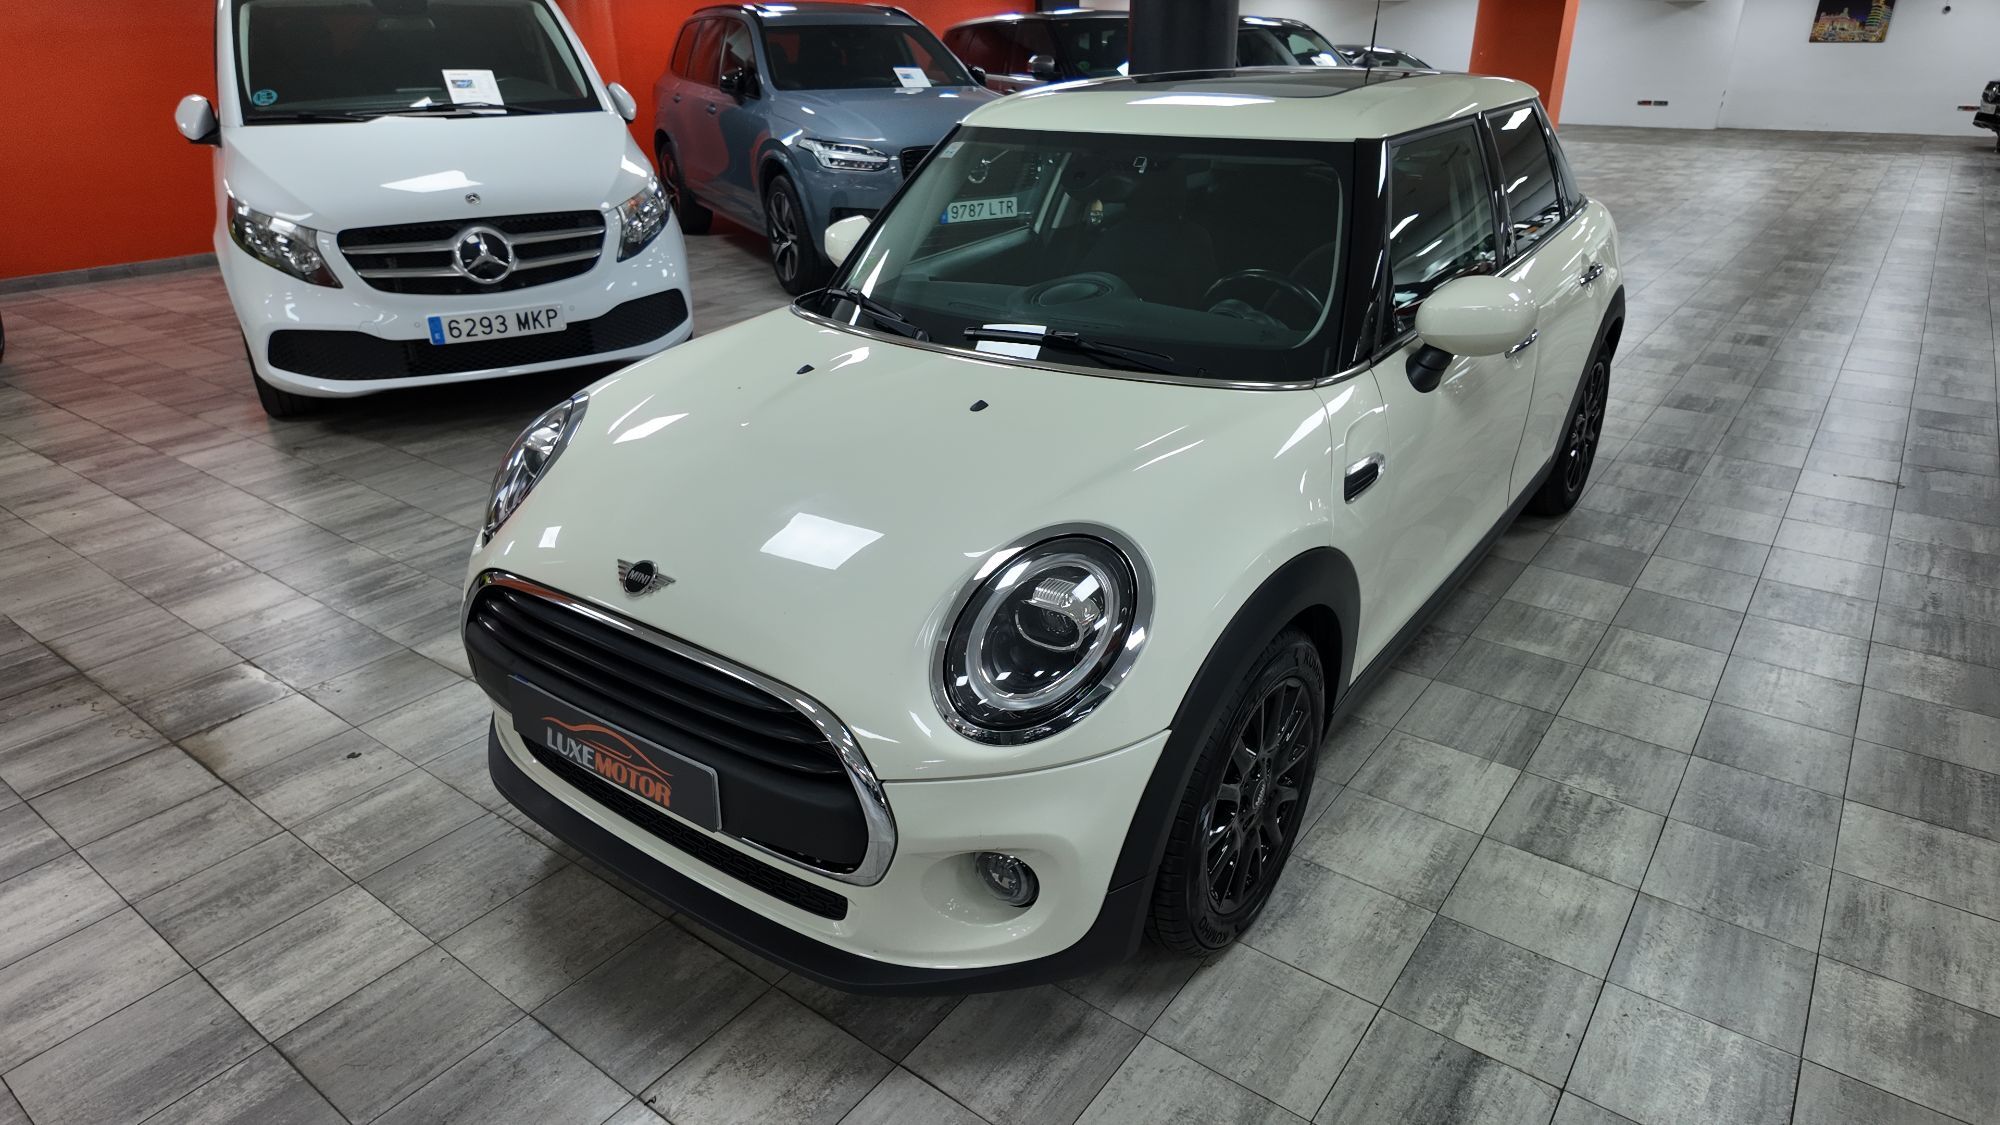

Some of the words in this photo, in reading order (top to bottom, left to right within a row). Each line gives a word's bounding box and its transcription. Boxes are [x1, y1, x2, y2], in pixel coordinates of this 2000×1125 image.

[951, 203, 985, 219] 9787
[989, 200, 1014, 216] LTR
[448, 315, 508, 338] 6293
[516, 308, 558, 331] MKP
[627, 569, 651, 585] MINI
[546, 726, 672, 807] LUXEMOTOR
